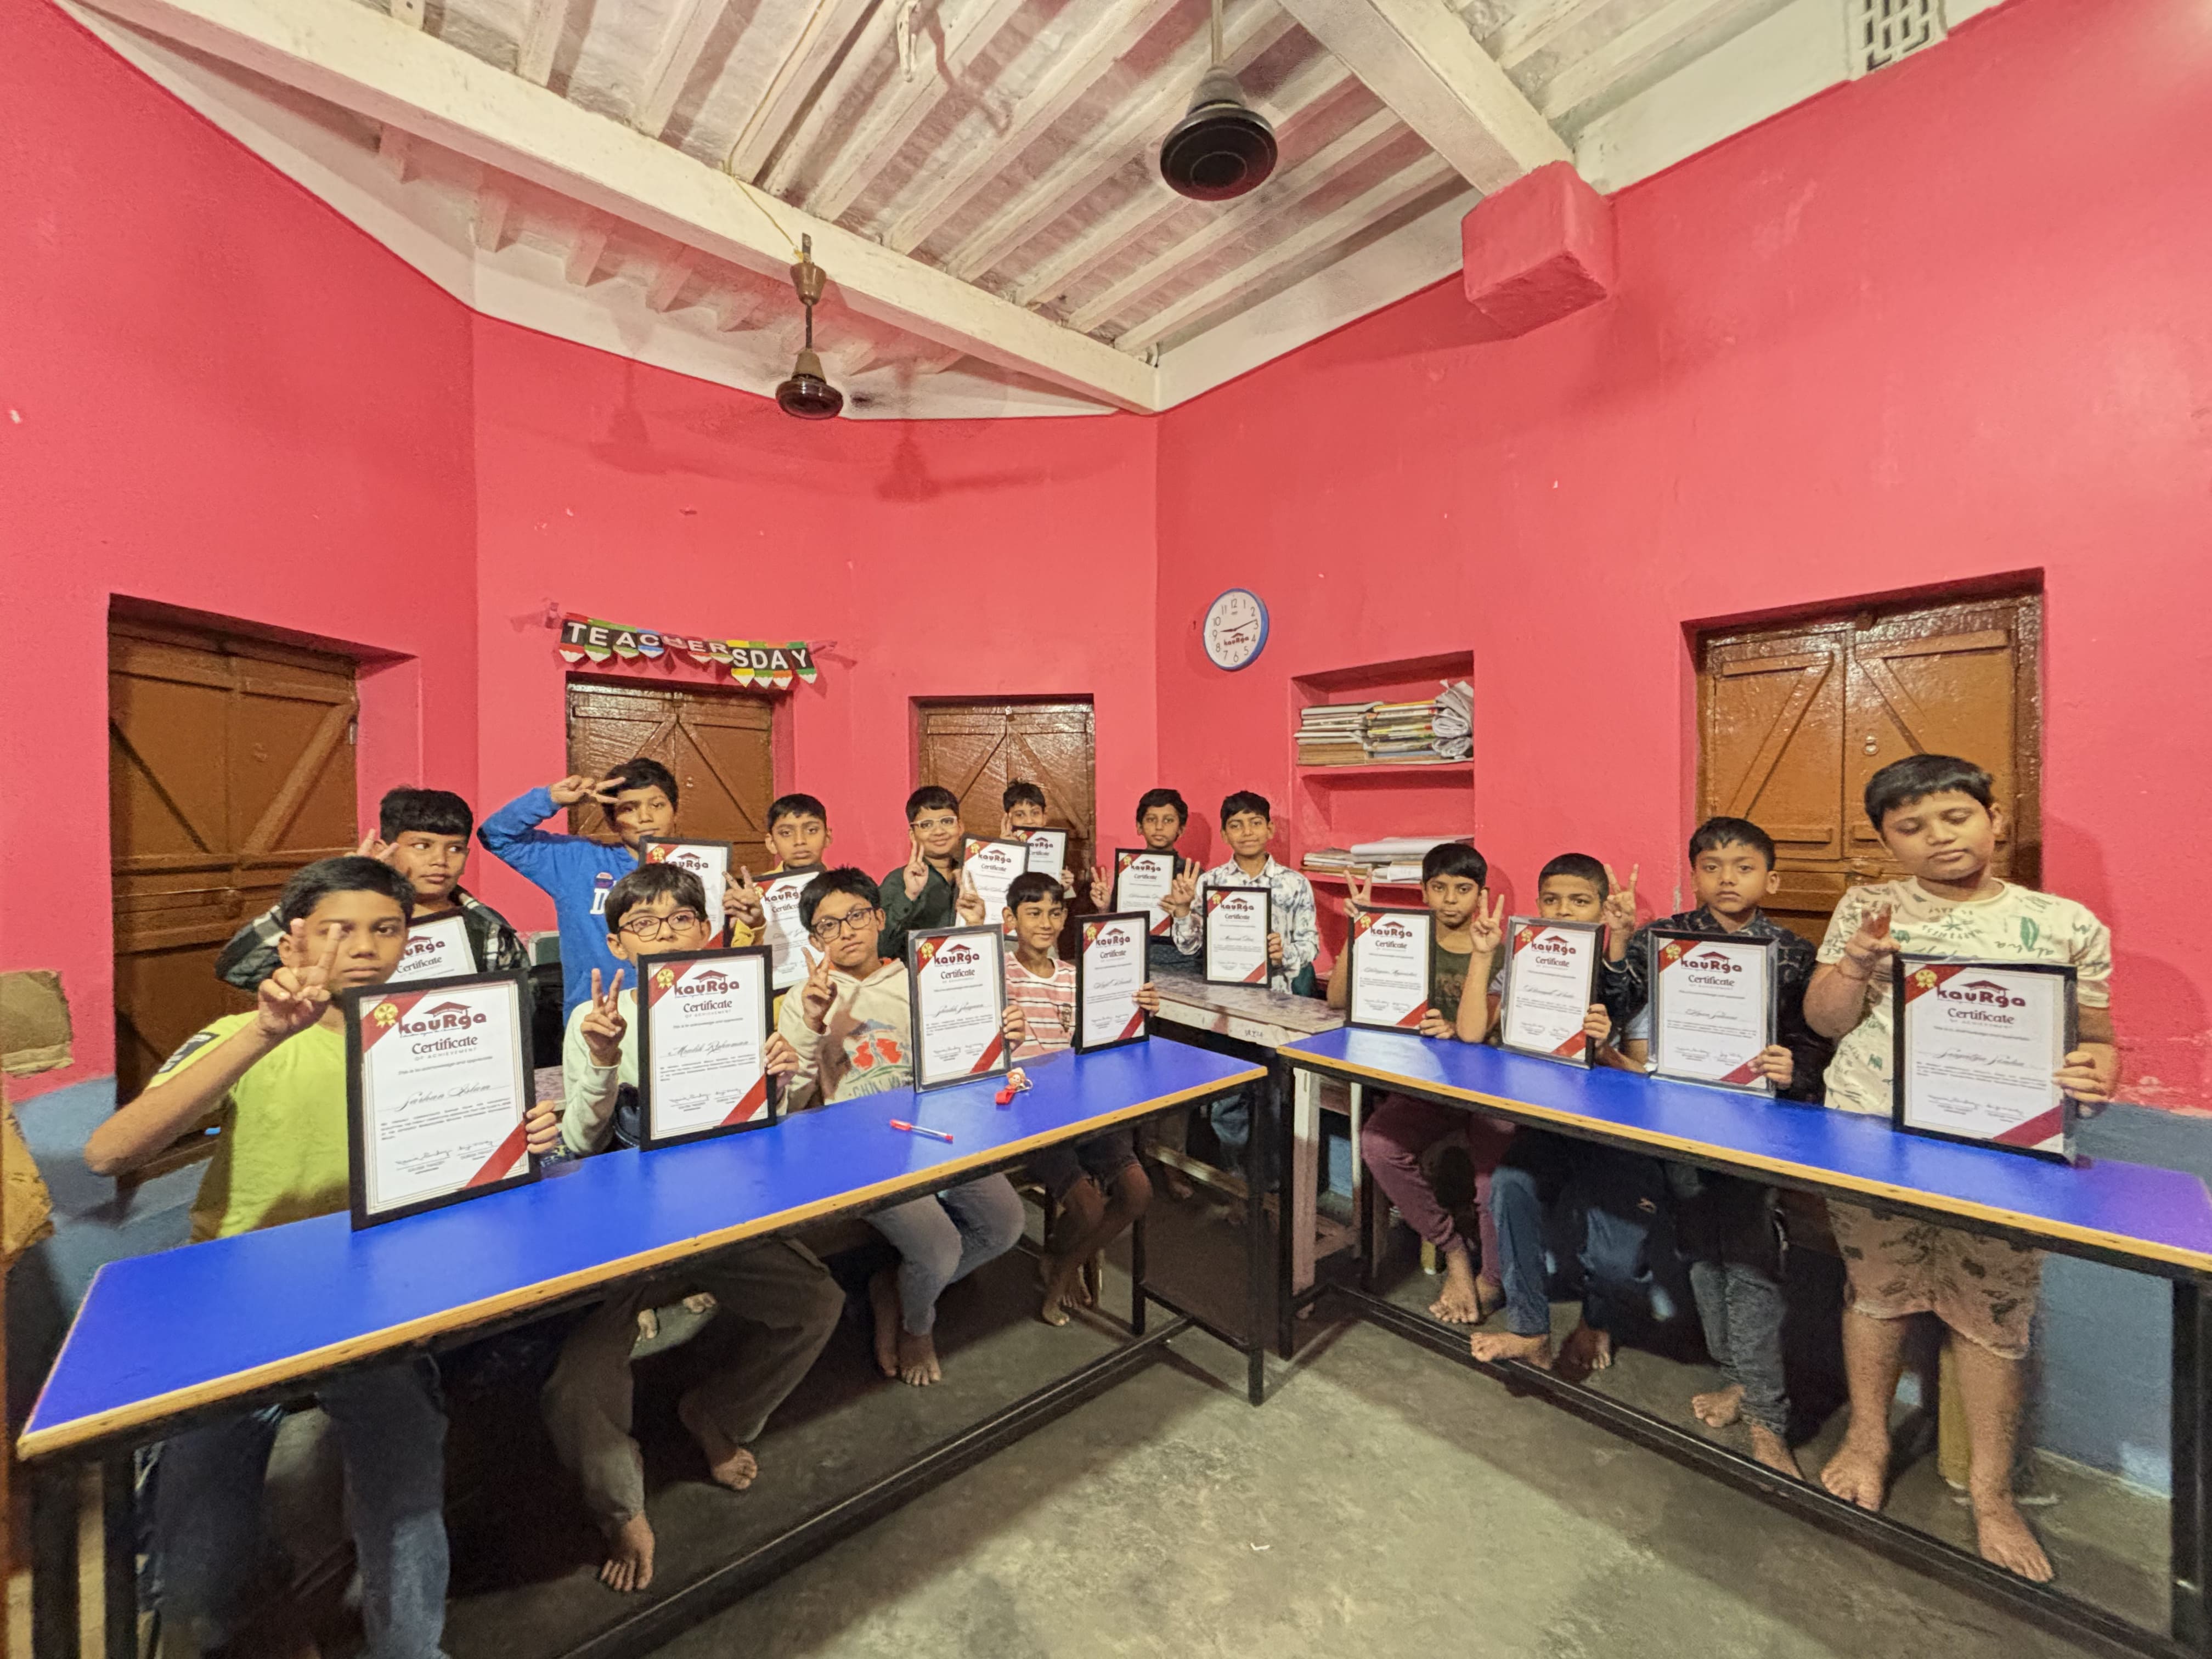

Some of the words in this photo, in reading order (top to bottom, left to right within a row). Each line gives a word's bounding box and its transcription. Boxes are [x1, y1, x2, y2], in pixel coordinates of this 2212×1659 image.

[1231, 599, 1237, 608] 12
[1221, 605, 1227, 614] 11
[1250, 607, 1255, 617] 2
[1213, 617, 1221, 626] 10
[1253, 619, 1259, 630] 3
[1212, 629, 1217, 641] 9
[1251, 634, 1256, 643] 4
[1216, 643, 1220, 652] 8
[1244, 646, 1249, 656] 5
[1223, 650, 1228, 661] 7
[1233, 651, 1238, 663] 6
[1375, 940, 1407, 950] Certificate
[1100, 950, 1126, 959] Certificate
[1536, 956, 1570, 967] Certificate
[941, 968, 975, 979] Certificate
[1688, 974, 1735, 987] Certificate
[683, 1000, 732, 1013] Certificate
[1948, 1008, 2015, 1024] Certificate
[412, 1036, 478, 1054] Certificate
